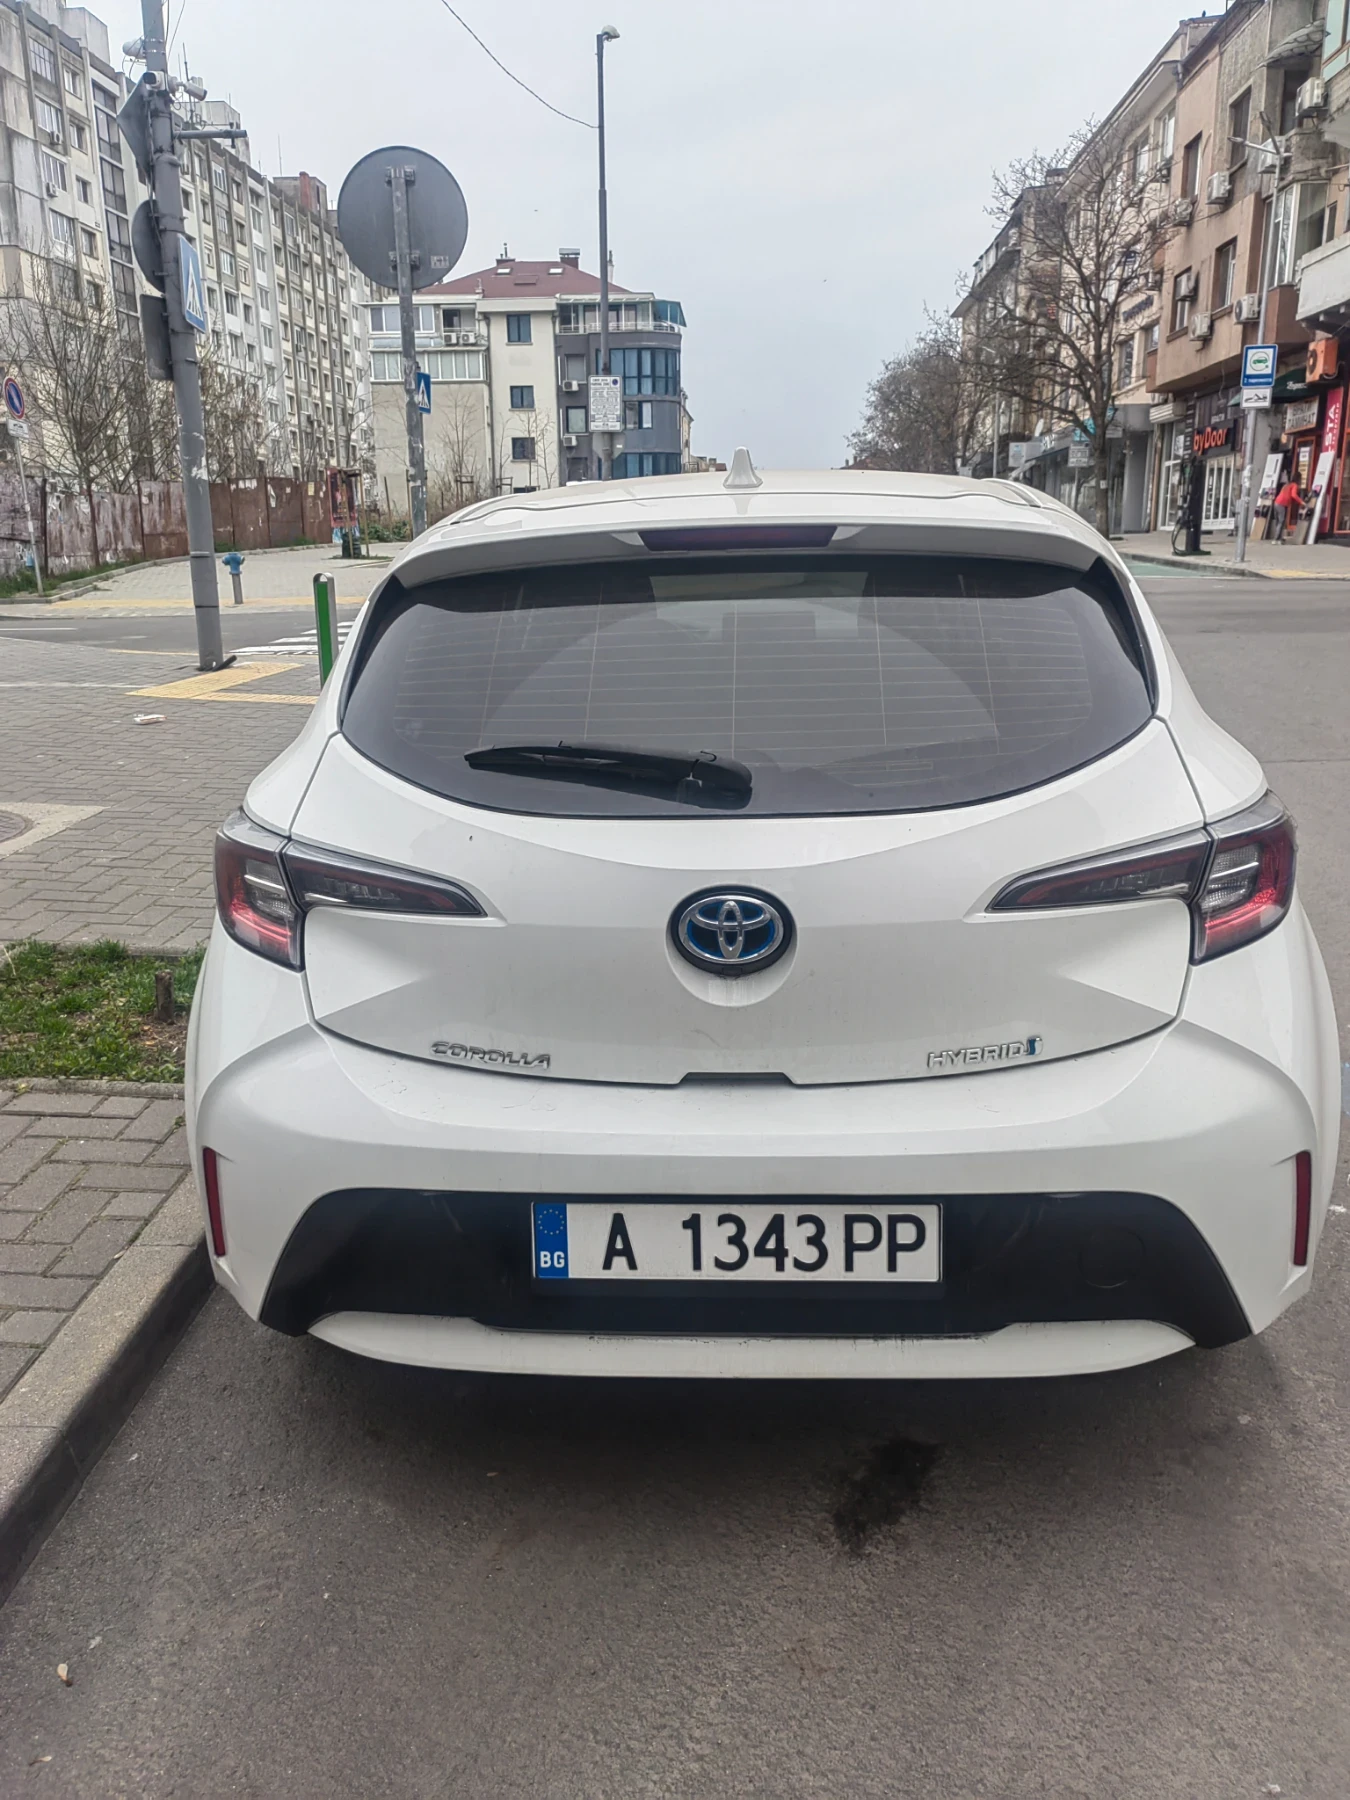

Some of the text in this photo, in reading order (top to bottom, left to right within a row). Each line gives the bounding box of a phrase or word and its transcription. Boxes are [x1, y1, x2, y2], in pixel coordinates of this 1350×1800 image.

[1193, 426, 1227, 456] byDoor
[431, 1041, 551, 1070] COROLLA
[927, 1042, 1026, 1068] HYBRID
[602, 1212, 638, 1271] A
[539, 1251, 566, 1269] BG
